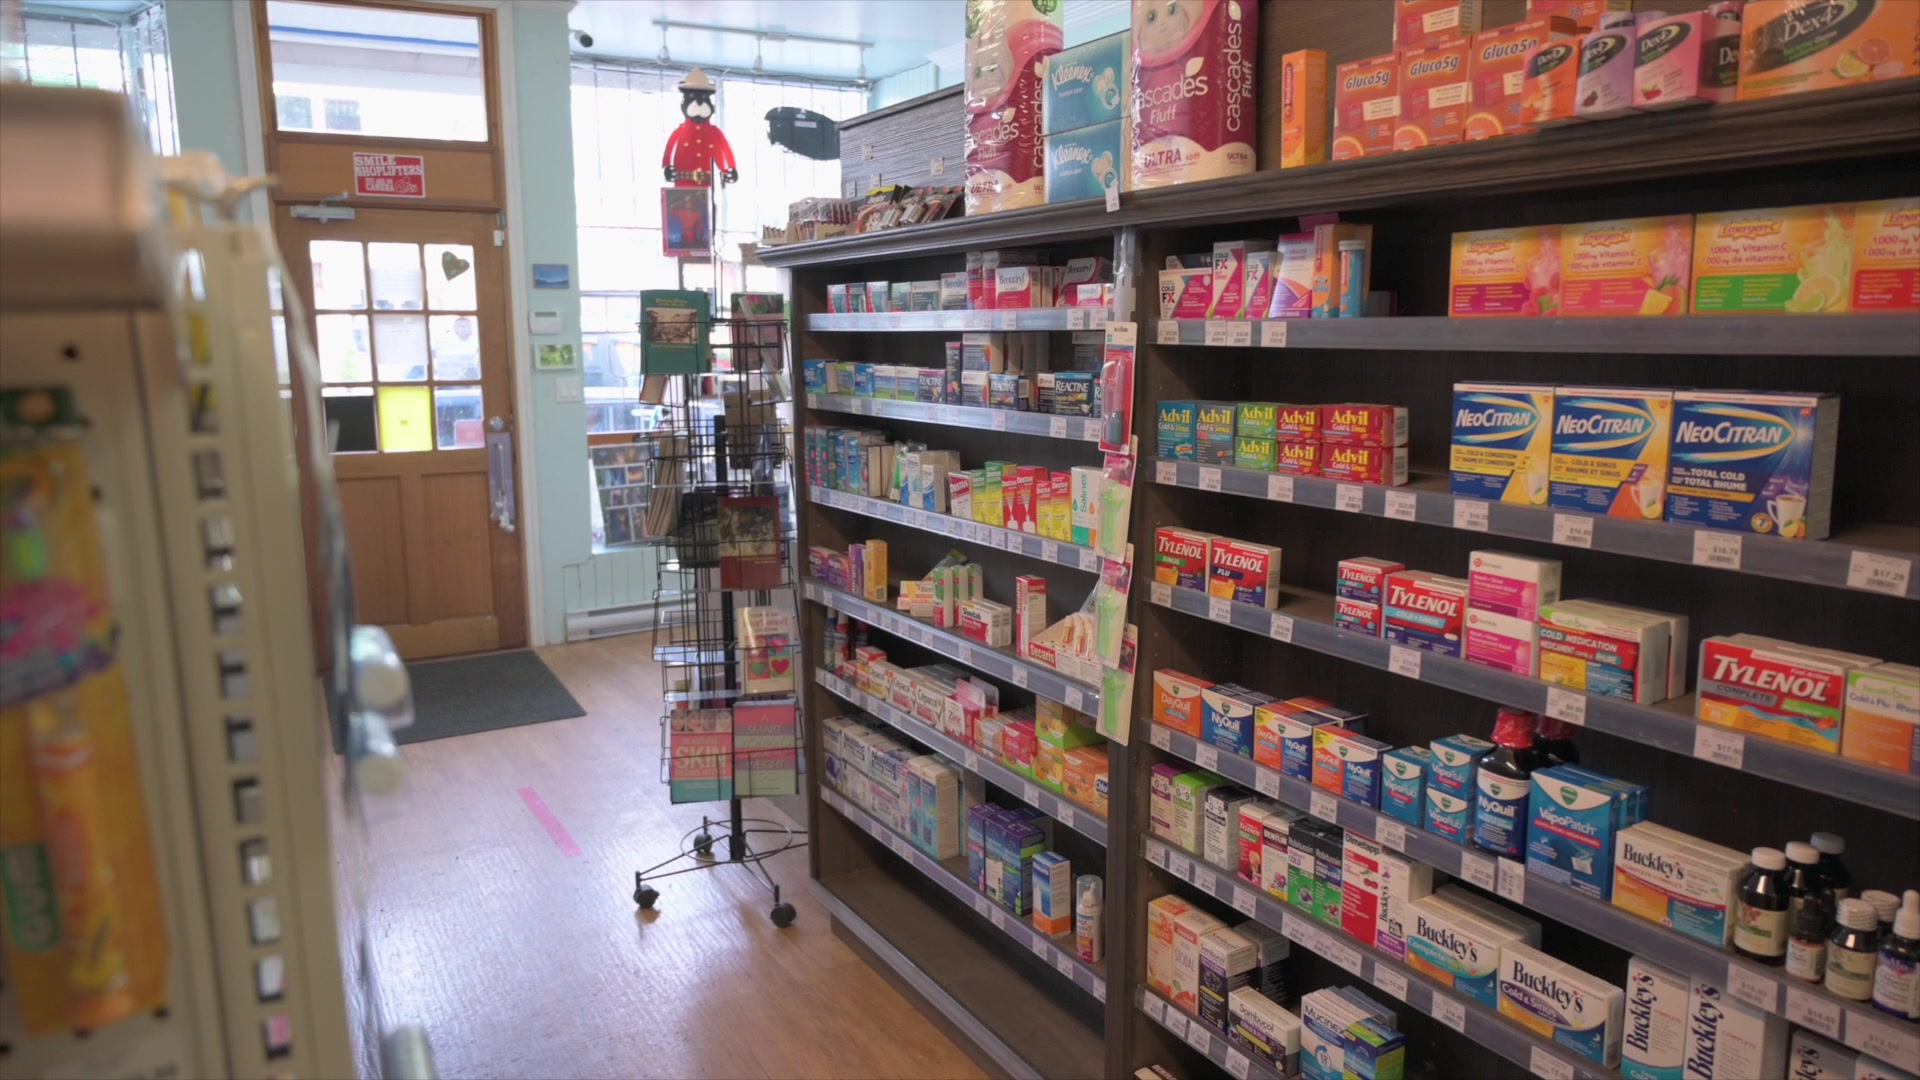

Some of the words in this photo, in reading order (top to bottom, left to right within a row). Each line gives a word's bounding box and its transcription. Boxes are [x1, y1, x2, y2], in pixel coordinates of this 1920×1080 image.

[1782, 8, 1837, 42] Dex4
[1410, 55, 1460, 76] Gluco5g
[1051, 64, 1093, 92] Kleenex
[1223, 22, 1242, 132] cascades
[1242, 60, 1252, 98] Fluff
[1285, 66, 1293, 105] Redoxon
[1345, 71, 1391, 90] Gluco5g
[1150, 104, 1176, 125] Fluff
[356, 155, 397, 166] SMILE
[977, 146, 998, 161] Fluff
[1051, 143, 1092, 170] Kleenex
[1144, 148, 1182, 168] ULTRA
[1227, 152, 1248, 161] ULTRA
[356, 165, 424, 176] SHOPLIFTERS
[1742, 243, 1780, 252] Vitamin
[1781, 242, 1788, 250] C
[1215, 259, 1228, 270] FX
[1731, 255, 1743, 264] de
[1744, 253, 1785, 264] vitamine
[1787, 253, 1795, 262] C
[1247, 271, 1259, 281] FX
[1161, 285, 1176, 293] COLD
[1162, 293, 1176, 304] FX
[919, 375, 943, 386] REACTINE
[990, 382, 1016, 392] REACTINE
[1055, 380, 1089, 392] REACTINE
[1159, 408, 1192, 424] Advil
[1197, 408, 1233, 424] Advil
[1241, 406, 1274, 420] Advil
[1280, 410, 1316, 425] Advil
[1330, 409, 1369, 426] Advil
[1158, 422, 1170, 430] Cold
[1197, 422, 1209, 431] Cold
[1332, 423, 1346, 431] Cold
[1239, 440, 1271, 454] Advil
[1281, 445, 1315, 460] Advil
[1281, 456, 1294, 464] Cold
[1330, 448, 1369, 465] Advil
[1571, 459, 1589, 467] COLD
[1690, 467, 1718, 479] TOTAL
[1720, 471, 1745, 481] COLD
[1080, 473, 1088, 513] Salinex
[1684, 477, 1712, 488] TOTAL
[1713, 480, 1747, 492] RHUME
[1158, 536, 1202, 560] TYLENOL
[1162, 555, 1180, 566] SINUS
[1213, 548, 1264, 574] TYLENOL
[1216, 568, 1231, 577] FLU
[1340, 568, 1377, 584] TYLENOL
[1390, 585, 1458, 618] TYLENOL
[1338, 603, 1373, 620] TYLENOL
[1396, 610, 1414, 621] COLD
[1541, 628, 1563, 640] COLD
[1566, 635, 1619, 652] MEDICATION
[1029, 643, 1056, 664] Secaris
[1713, 654, 1827, 702] TYLENOL
[1161, 692, 1192, 712] DayQuil
[1716, 684, 1772, 704] COMPLETE
[1850, 692, 1869, 703] Cold
[748, 725, 783, 734] SMART
[1211, 712, 1241, 733] NyQuil
[1256, 728, 1279, 742] DayQuil
[1284, 738, 1308, 754] NyQuil
[675, 746, 728, 769] SKIN
[1315, 751, 1341, 766] DayQuil
[1346, 762, 1372, 778] NyQuil
[1432, 763, 1466, 783] VapoRub
[1383, 777, 1417, 798] VapoRub
[1478, 795, 1517, 818] NyQuil
[1428, 808, 1462, 829] VapoRub
[1538, 806, 1598, 836] VapoPatch
[1239, 821, 1260, 836] TYLENOL
[1263, 829, 1288, 844] BENYLIN
[1345, 833, 1381, 855] Dimetapp
[1622, 842, 1685, 881] Buckley's
[1417, 915, 1478, 963] Buckley's
[1407, 936, 1447, 963] Complete
[1512, 960, 1584, 1014] Buckley's
[1501, 981, 1523, 1001] Cold
[1530, 997, 1557, 1018] Sinus
[1239, 1003, 1275, 1033] Sambucol
[1304, 1004, 1346, 1035] Mucinex
[1626, 972, 1657, 1053] Buckley's
[1687, 983, 1724, 1080] Buckley's
[1722, 1029, 1757, 1050] COMPLETE
[1320, 1053, 1329, 1063] 12
